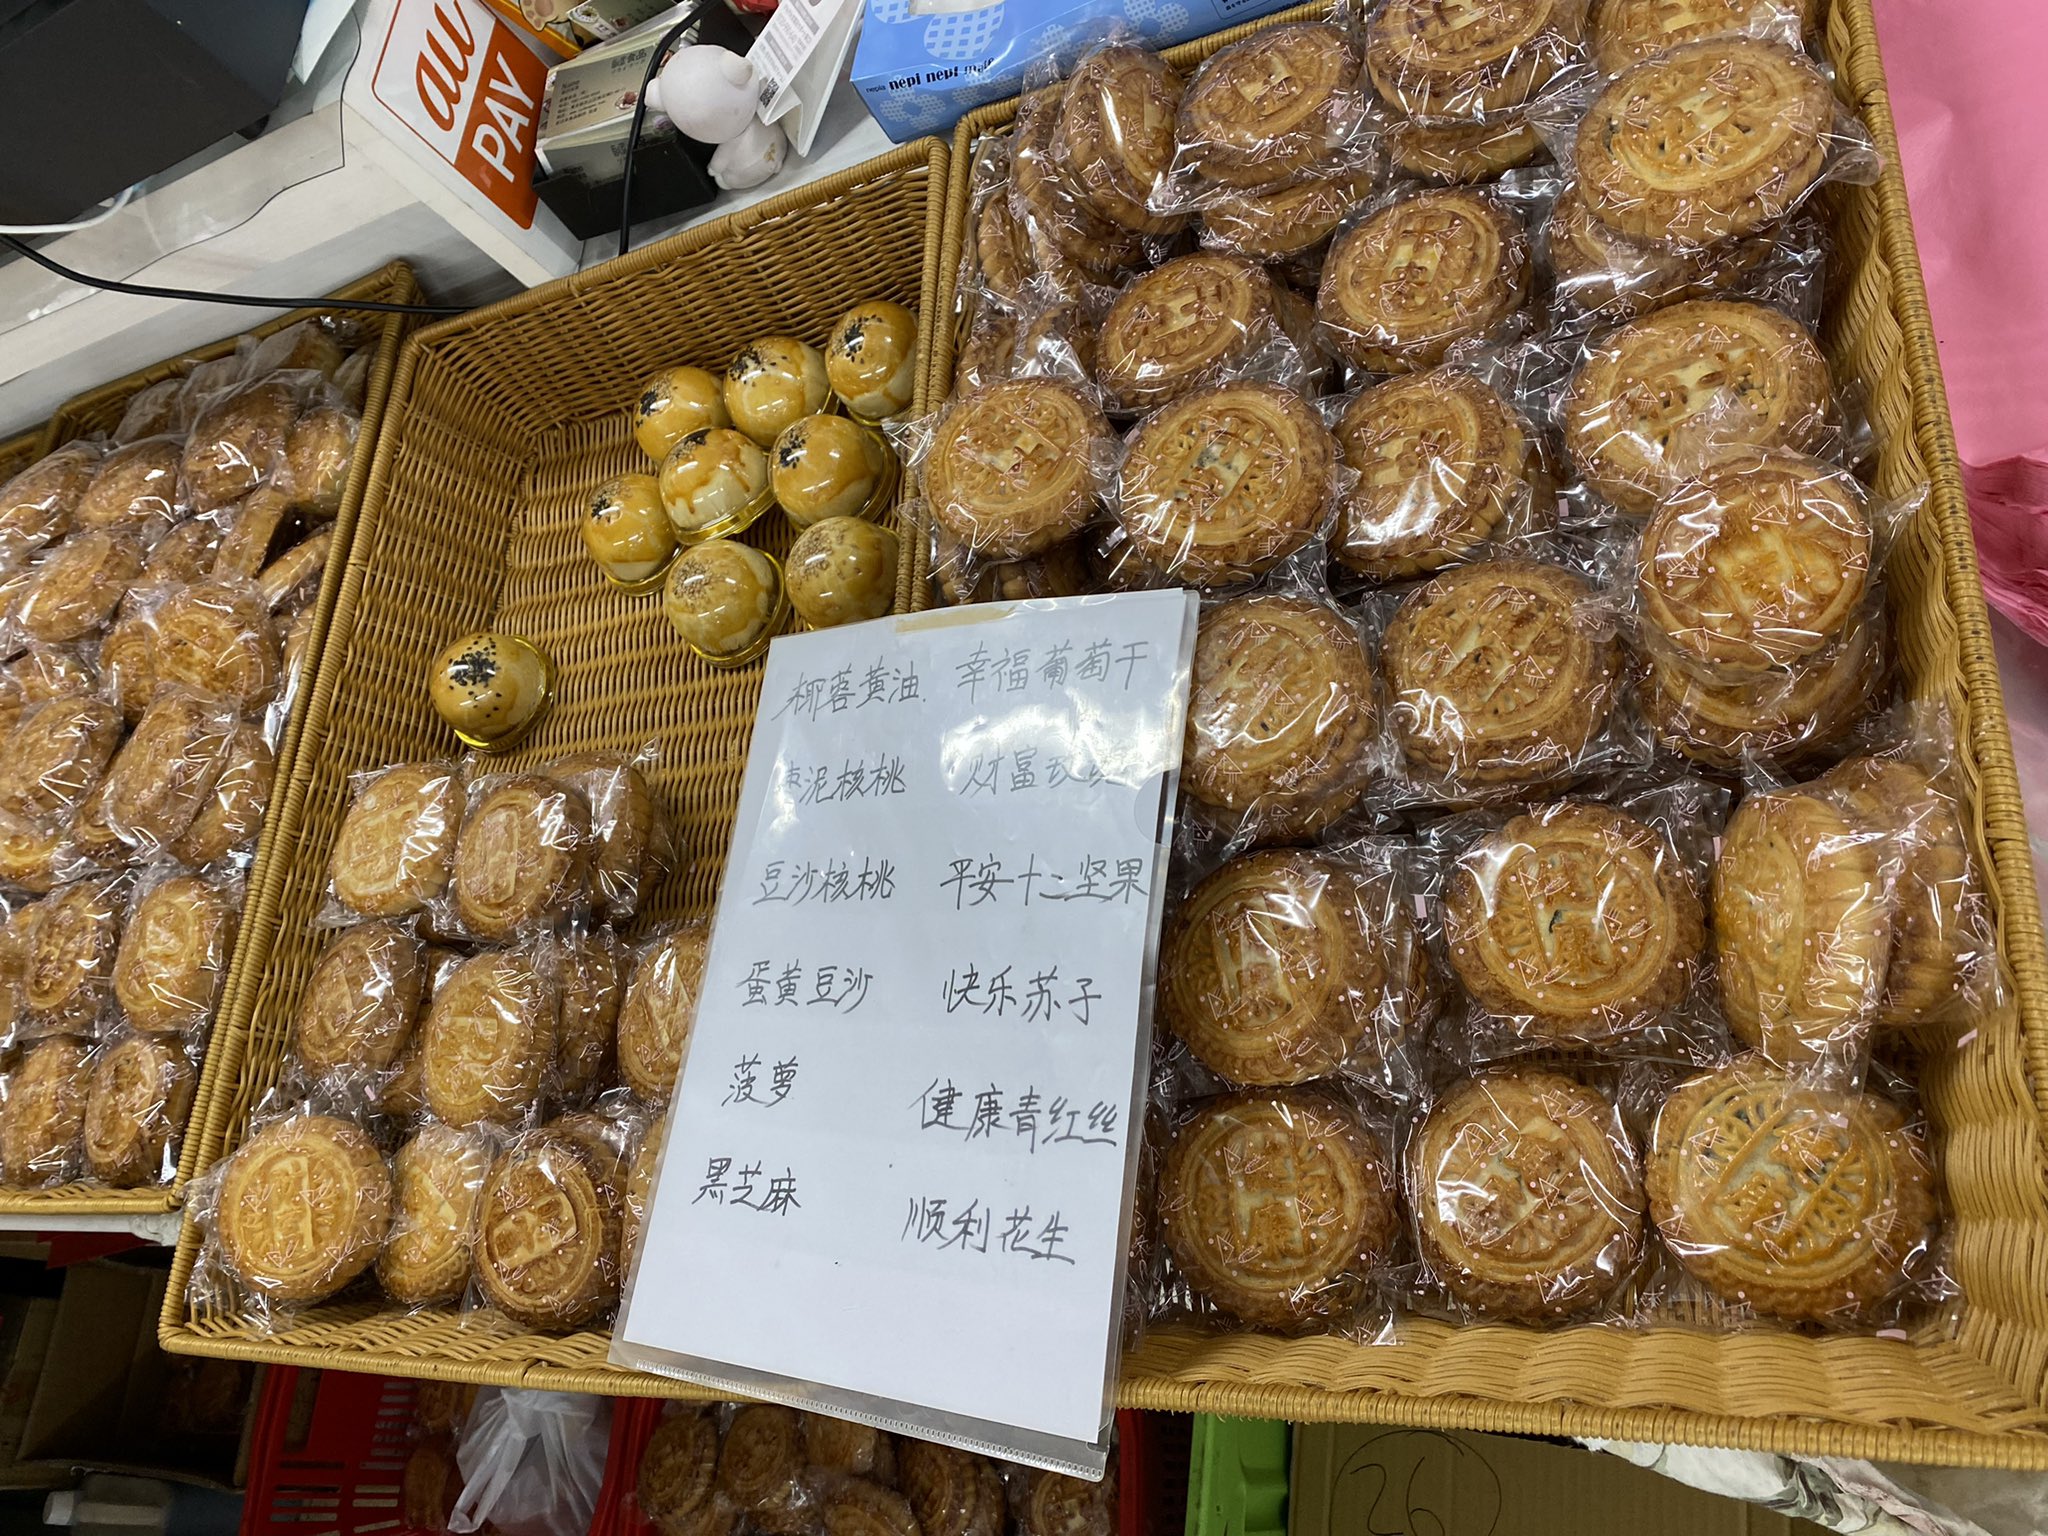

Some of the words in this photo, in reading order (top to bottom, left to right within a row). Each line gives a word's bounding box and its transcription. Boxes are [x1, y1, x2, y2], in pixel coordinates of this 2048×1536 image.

[416, 0, 475, 131] au
[888, 72, 921, 90] nepi
[926, 66, 958, 83] nepi
[472, 51, 535, 183] PAY
[955, 638, 1149, 704] 幸福葡萄干
[752, 856, 897, 906] 豆沙核桃
[737, 957, 874, 1014] 蛋黄豆沙
[942, 963, 1102, 1025] 快乐苏子
[721, 1053, 799, 1108] 菠萝
[909, 1078, 1118, 1154] 健康青红丝
[691, 1157, 802, 1216] 黑芝麻
[901, 1196, 1076, 1265] 顺利花生
